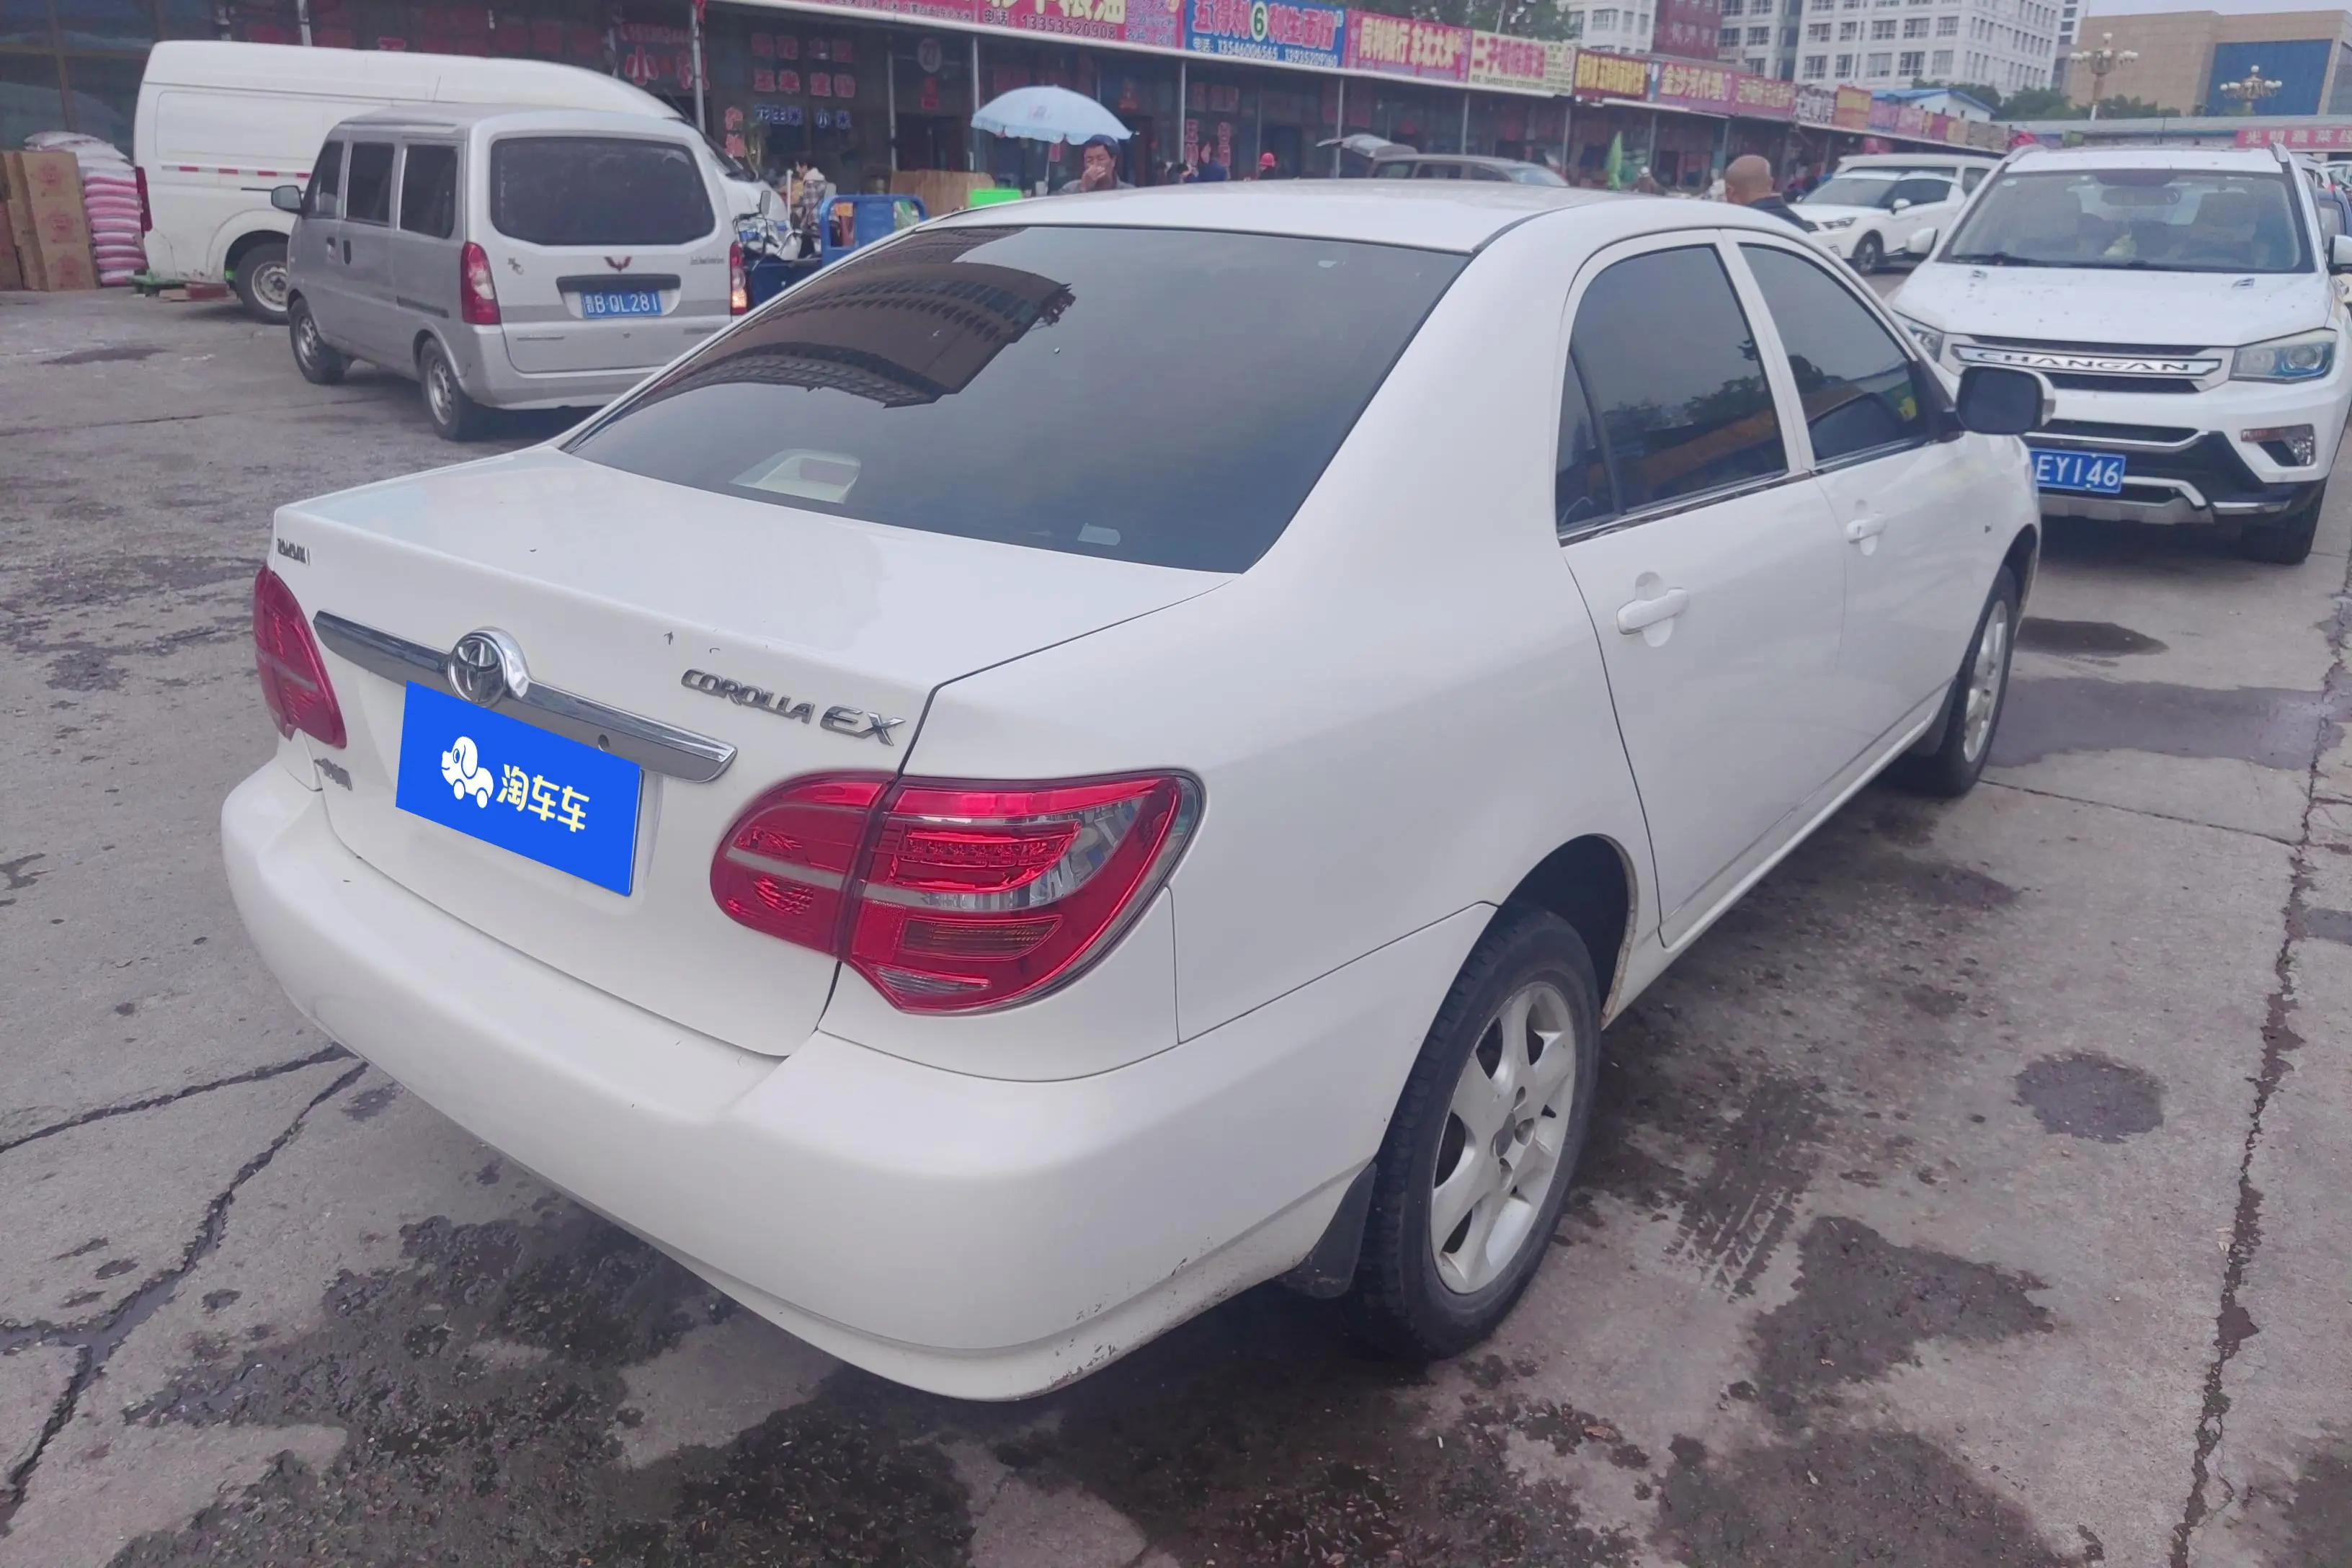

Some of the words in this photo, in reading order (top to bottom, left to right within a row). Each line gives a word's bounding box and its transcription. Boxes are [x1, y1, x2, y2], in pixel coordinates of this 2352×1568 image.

[1022, 14, 1116, 40] 13353520908
[1977, 352, 2190, 371] CHANGAN
[681, 668, 816, 724] COROLLA
[820, 705, 906, 747] EX
